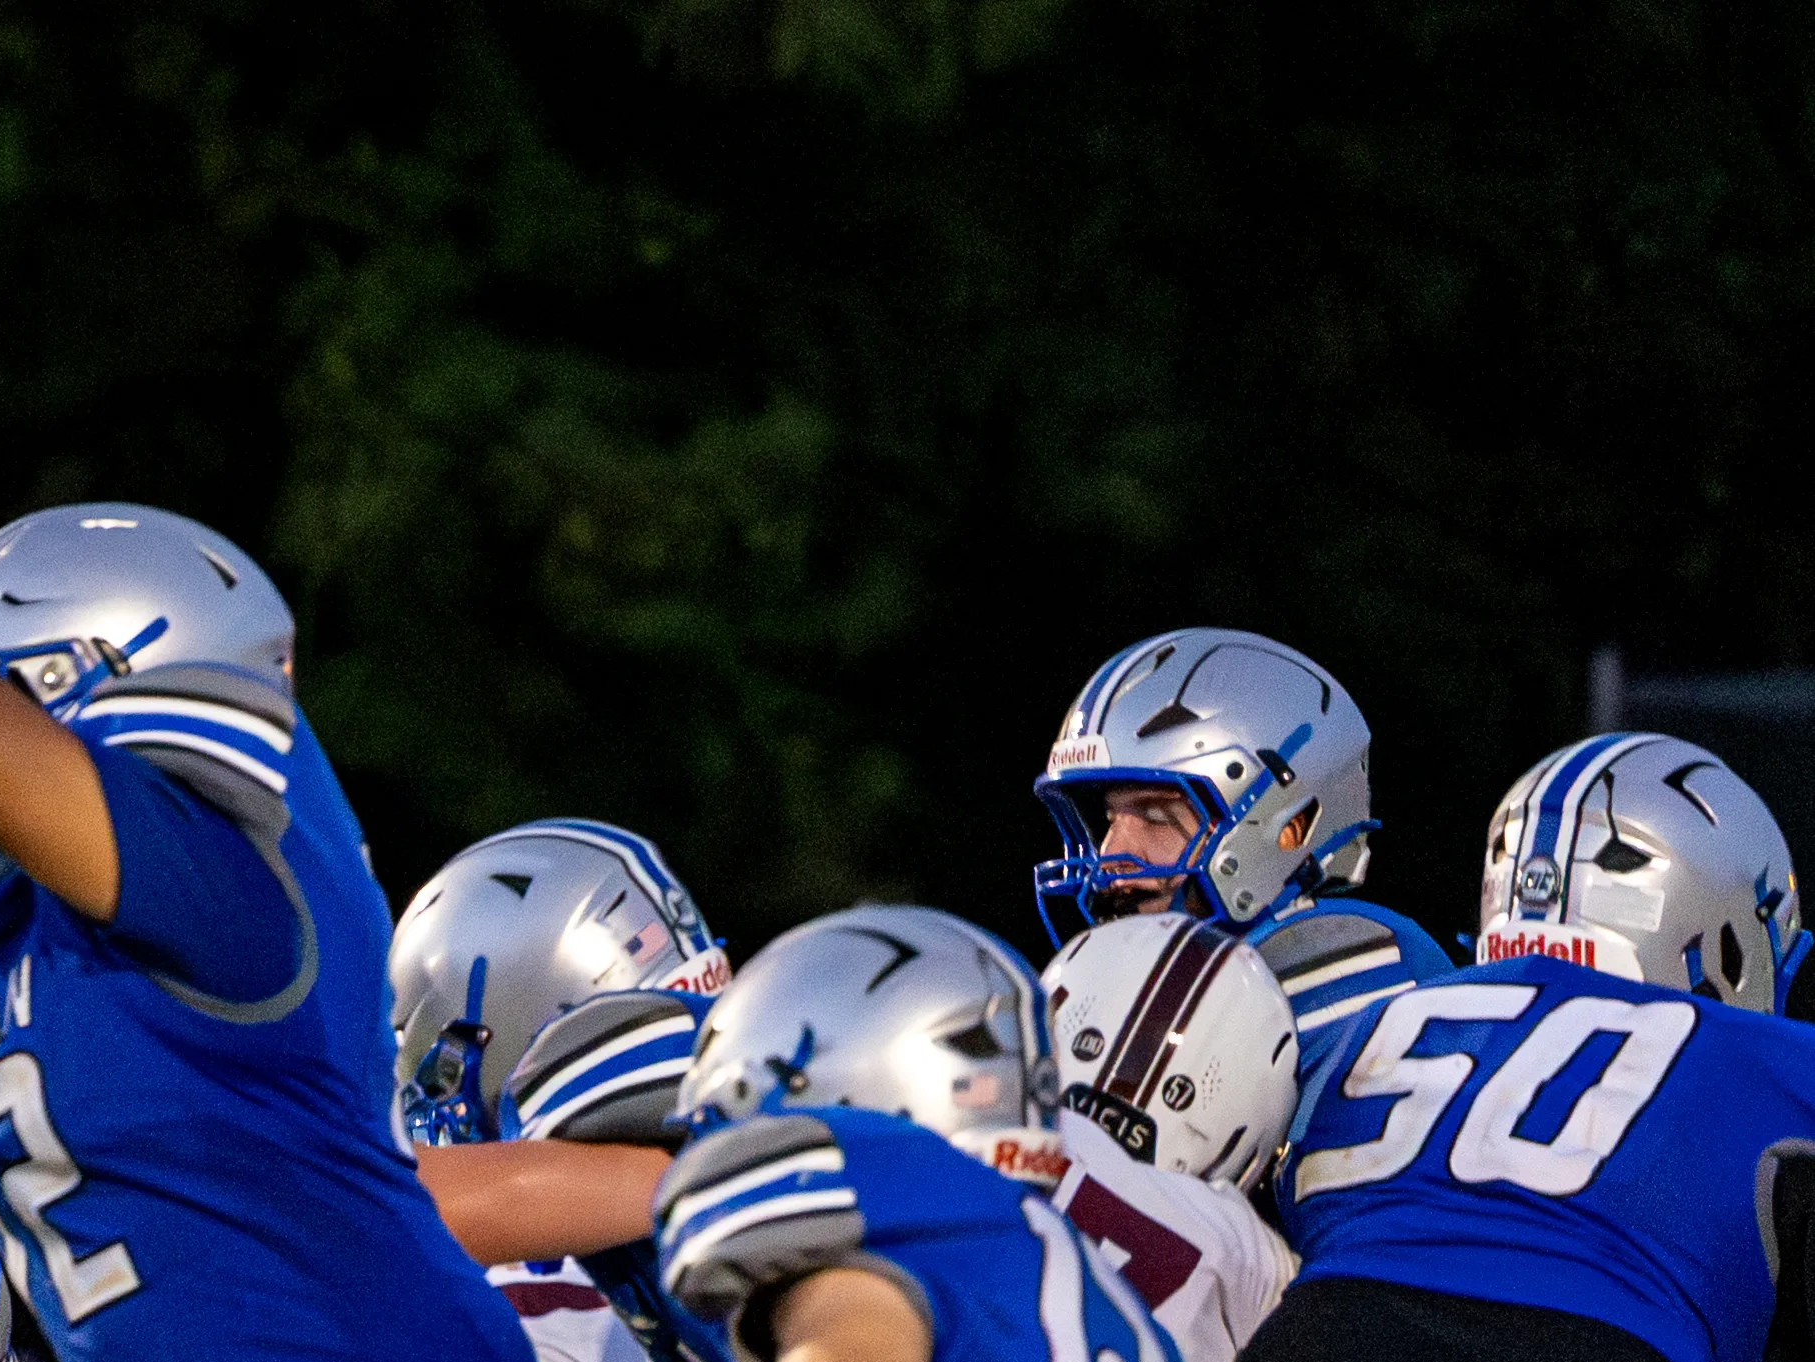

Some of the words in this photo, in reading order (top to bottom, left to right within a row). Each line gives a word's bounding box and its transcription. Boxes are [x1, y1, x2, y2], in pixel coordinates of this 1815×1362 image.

[1487, 932, 1596, 969] Riddell
[1166, 1076, 1194, 1111] 57
[1295, 984, 1698, 1202] 50
